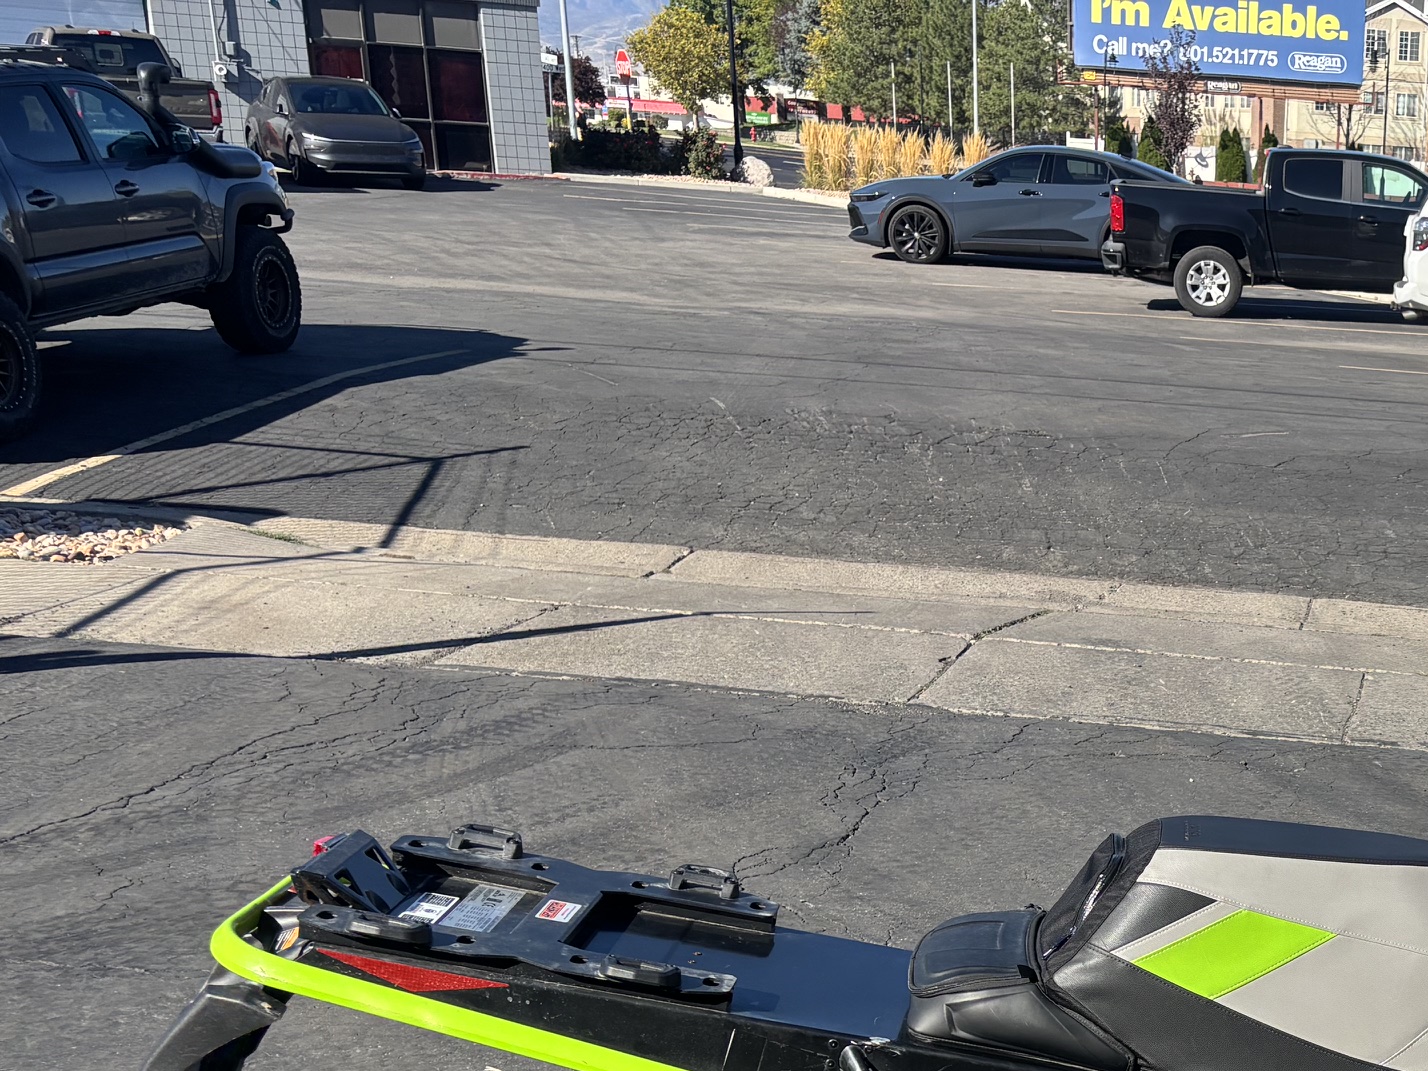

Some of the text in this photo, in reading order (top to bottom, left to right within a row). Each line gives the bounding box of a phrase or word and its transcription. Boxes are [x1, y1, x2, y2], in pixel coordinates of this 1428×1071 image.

[1091, 0, 1349, 41] I'm Available.
[1092, 34, 1128, 56] Call
[1131, 39, 1172, 58] me?
[617, 61, 631, 76] STOP
[1293, 53, 1342, 71] Reagan
